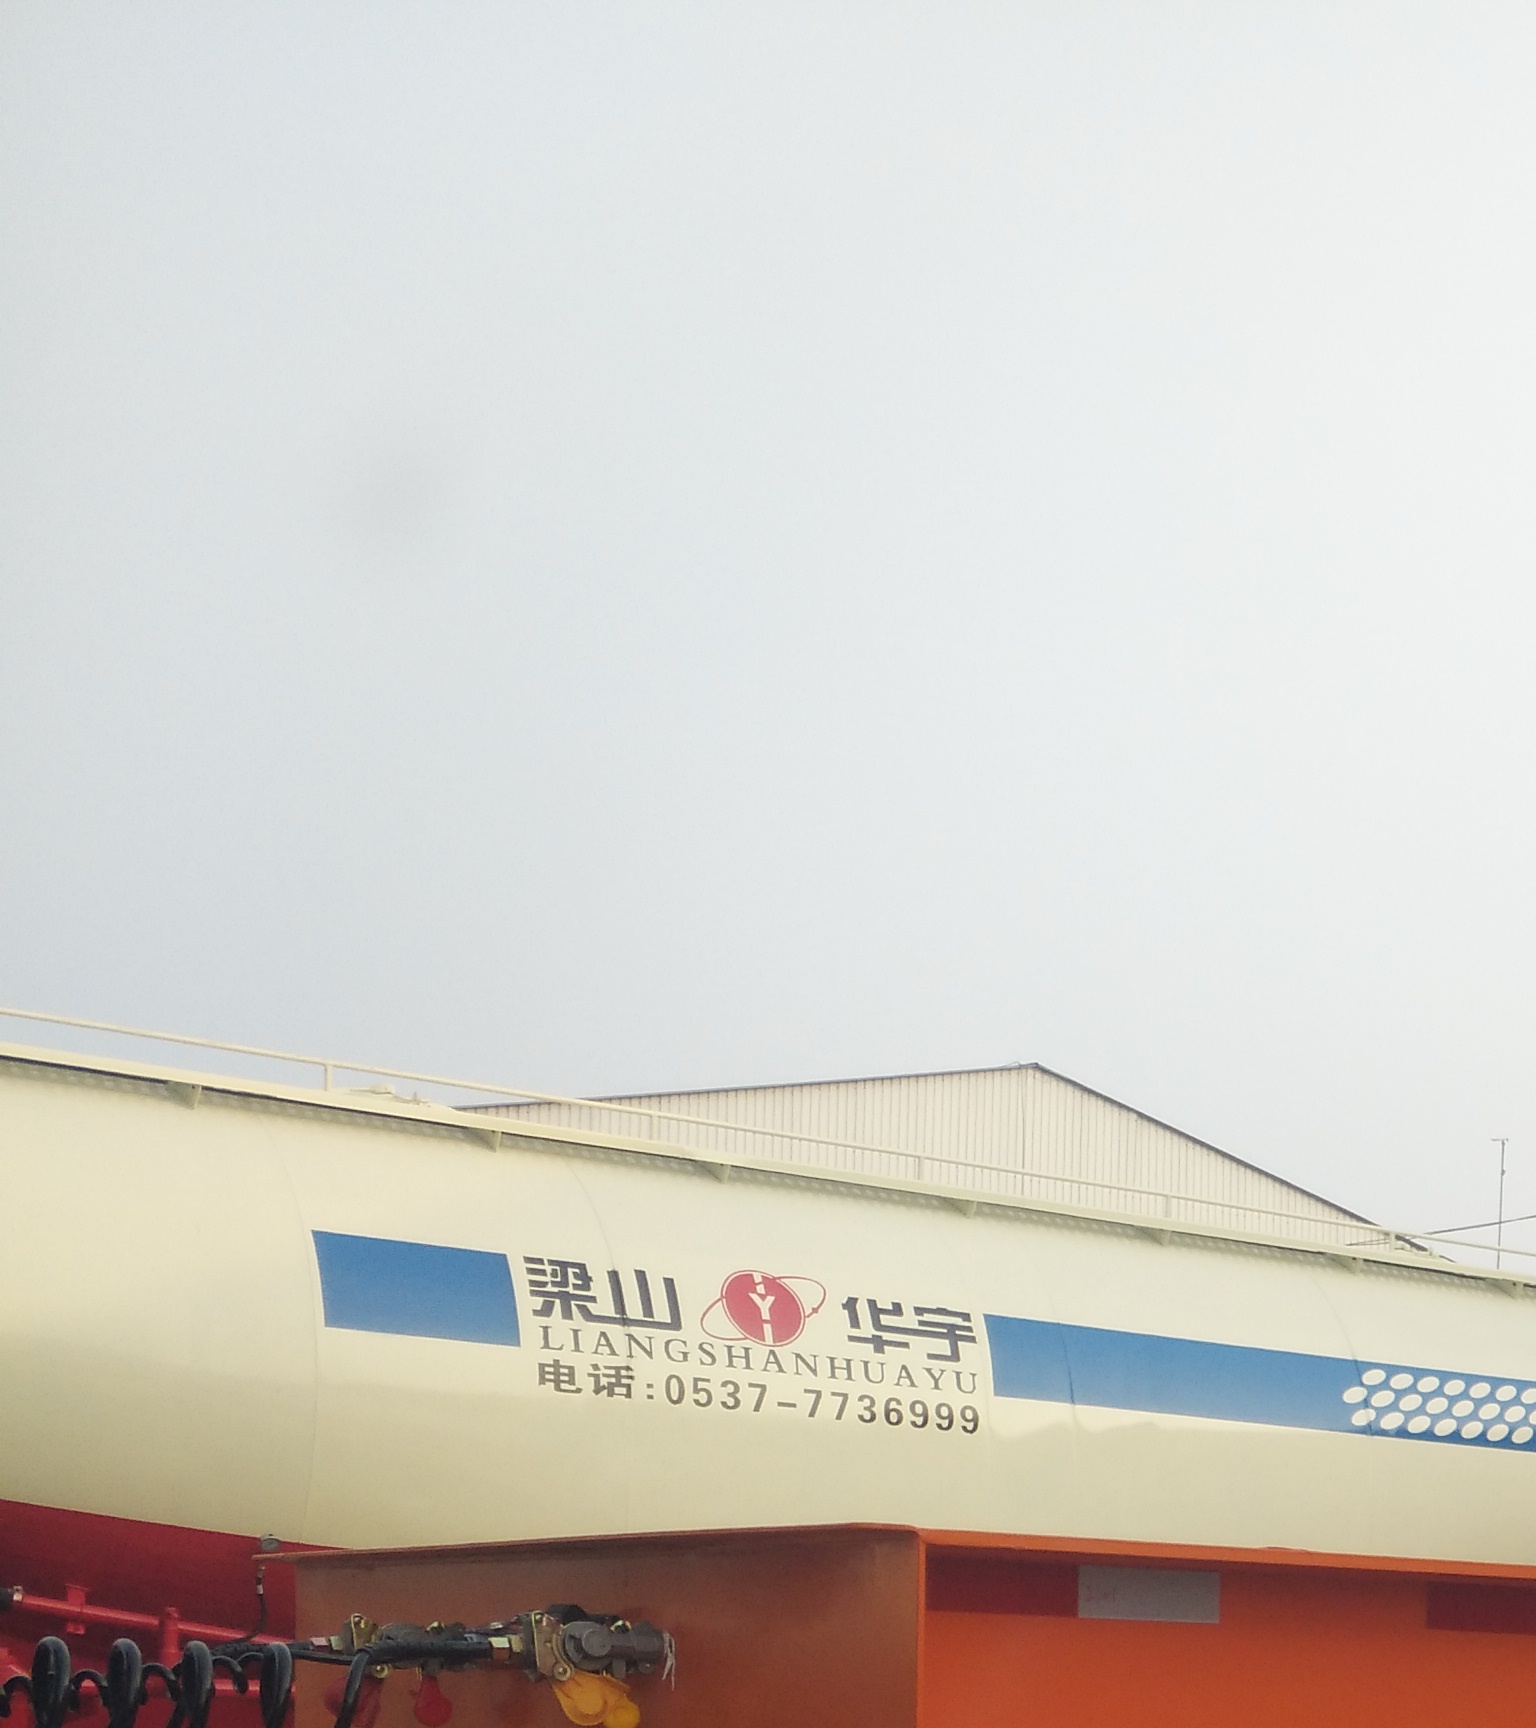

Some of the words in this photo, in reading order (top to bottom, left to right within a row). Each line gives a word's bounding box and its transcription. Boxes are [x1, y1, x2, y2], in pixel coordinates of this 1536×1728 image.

[523, 1256, 682, 1331] 梁山
[842, 1297, 978, 1363] 华宇
[538, 1359, 980, 1435] 电话:0537-7736999
[540, 1326, 978, 1394] LIANGSHANHUAYU
